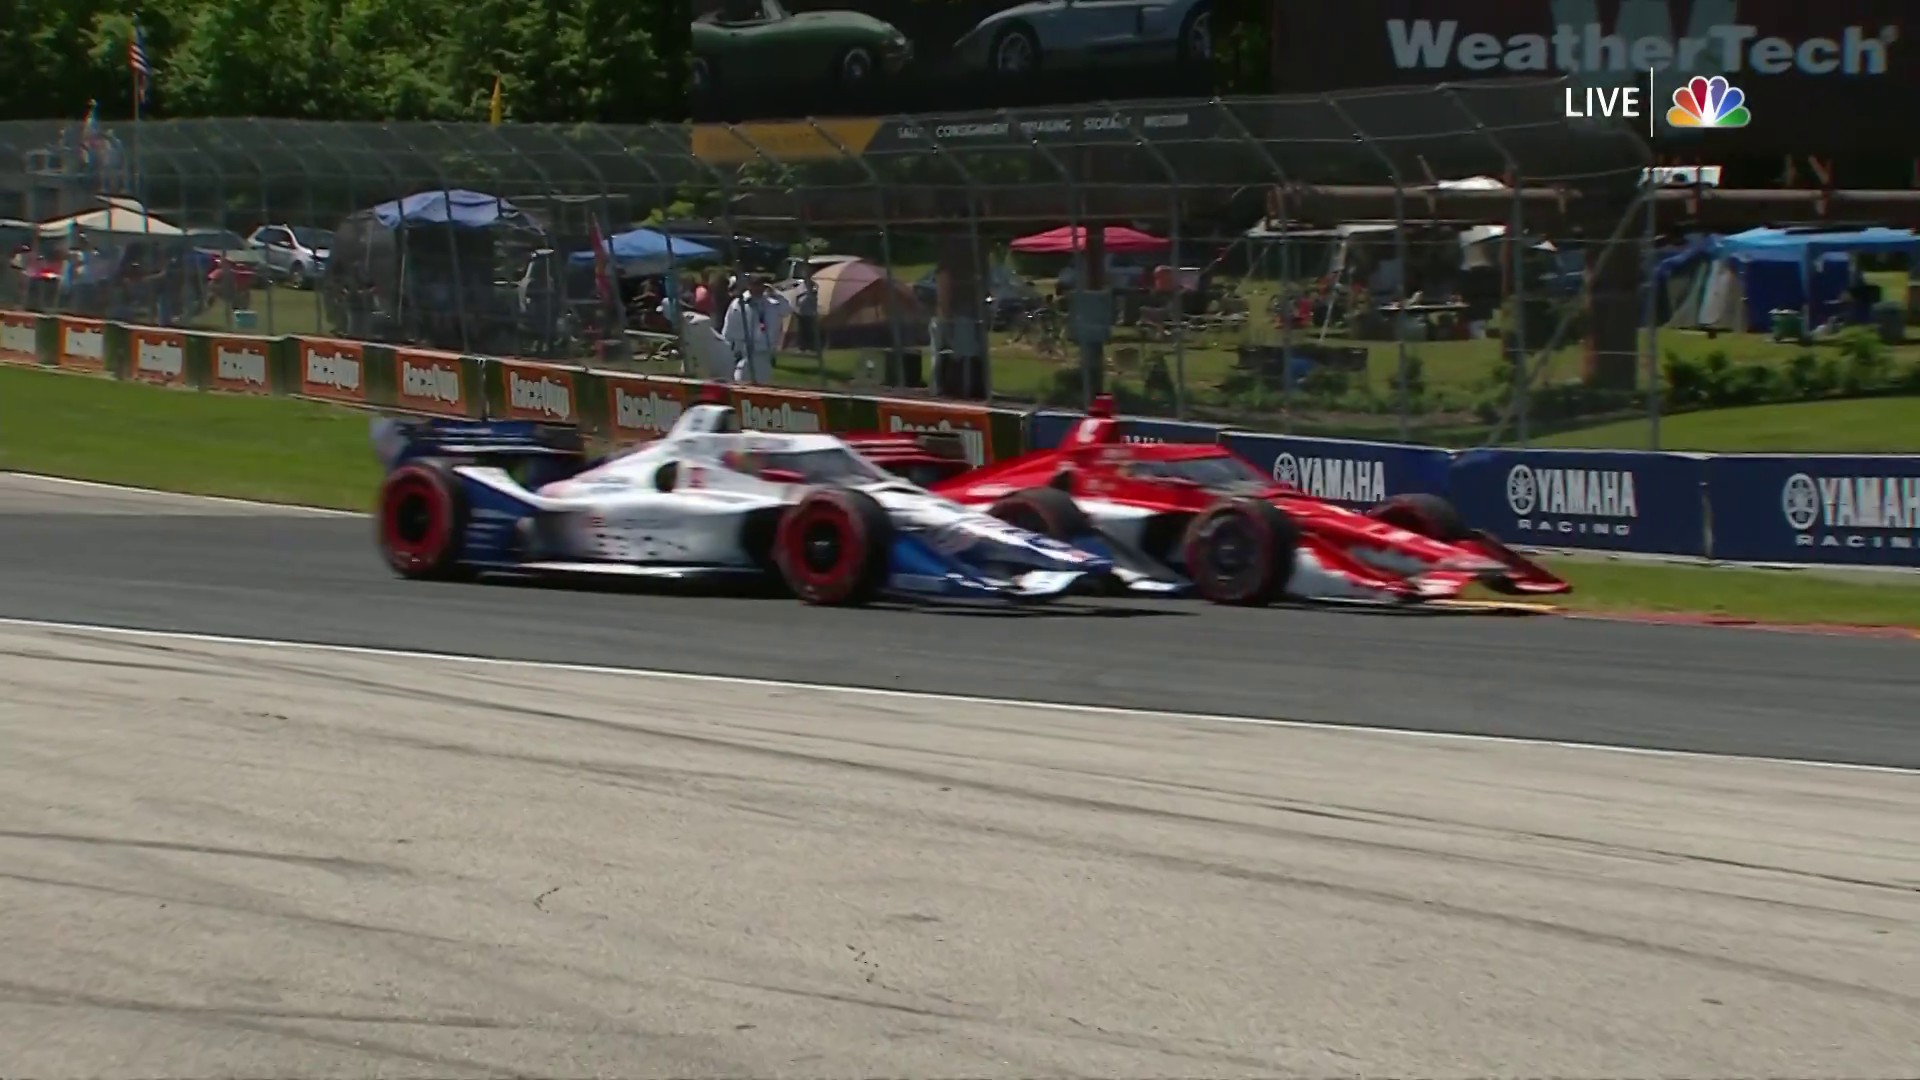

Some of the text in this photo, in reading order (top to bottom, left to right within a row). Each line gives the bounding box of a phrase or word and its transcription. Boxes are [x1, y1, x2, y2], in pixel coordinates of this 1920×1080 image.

[1386, 19, 1889, 74] WeatherTech
[1298, 457, 1386, 502] YAMAHA
[1534, 468, 1638, 518] YAMAHA
[1517, 519, 1630, 536] RACING
[1795, 534, 1920, 549] RACIN
